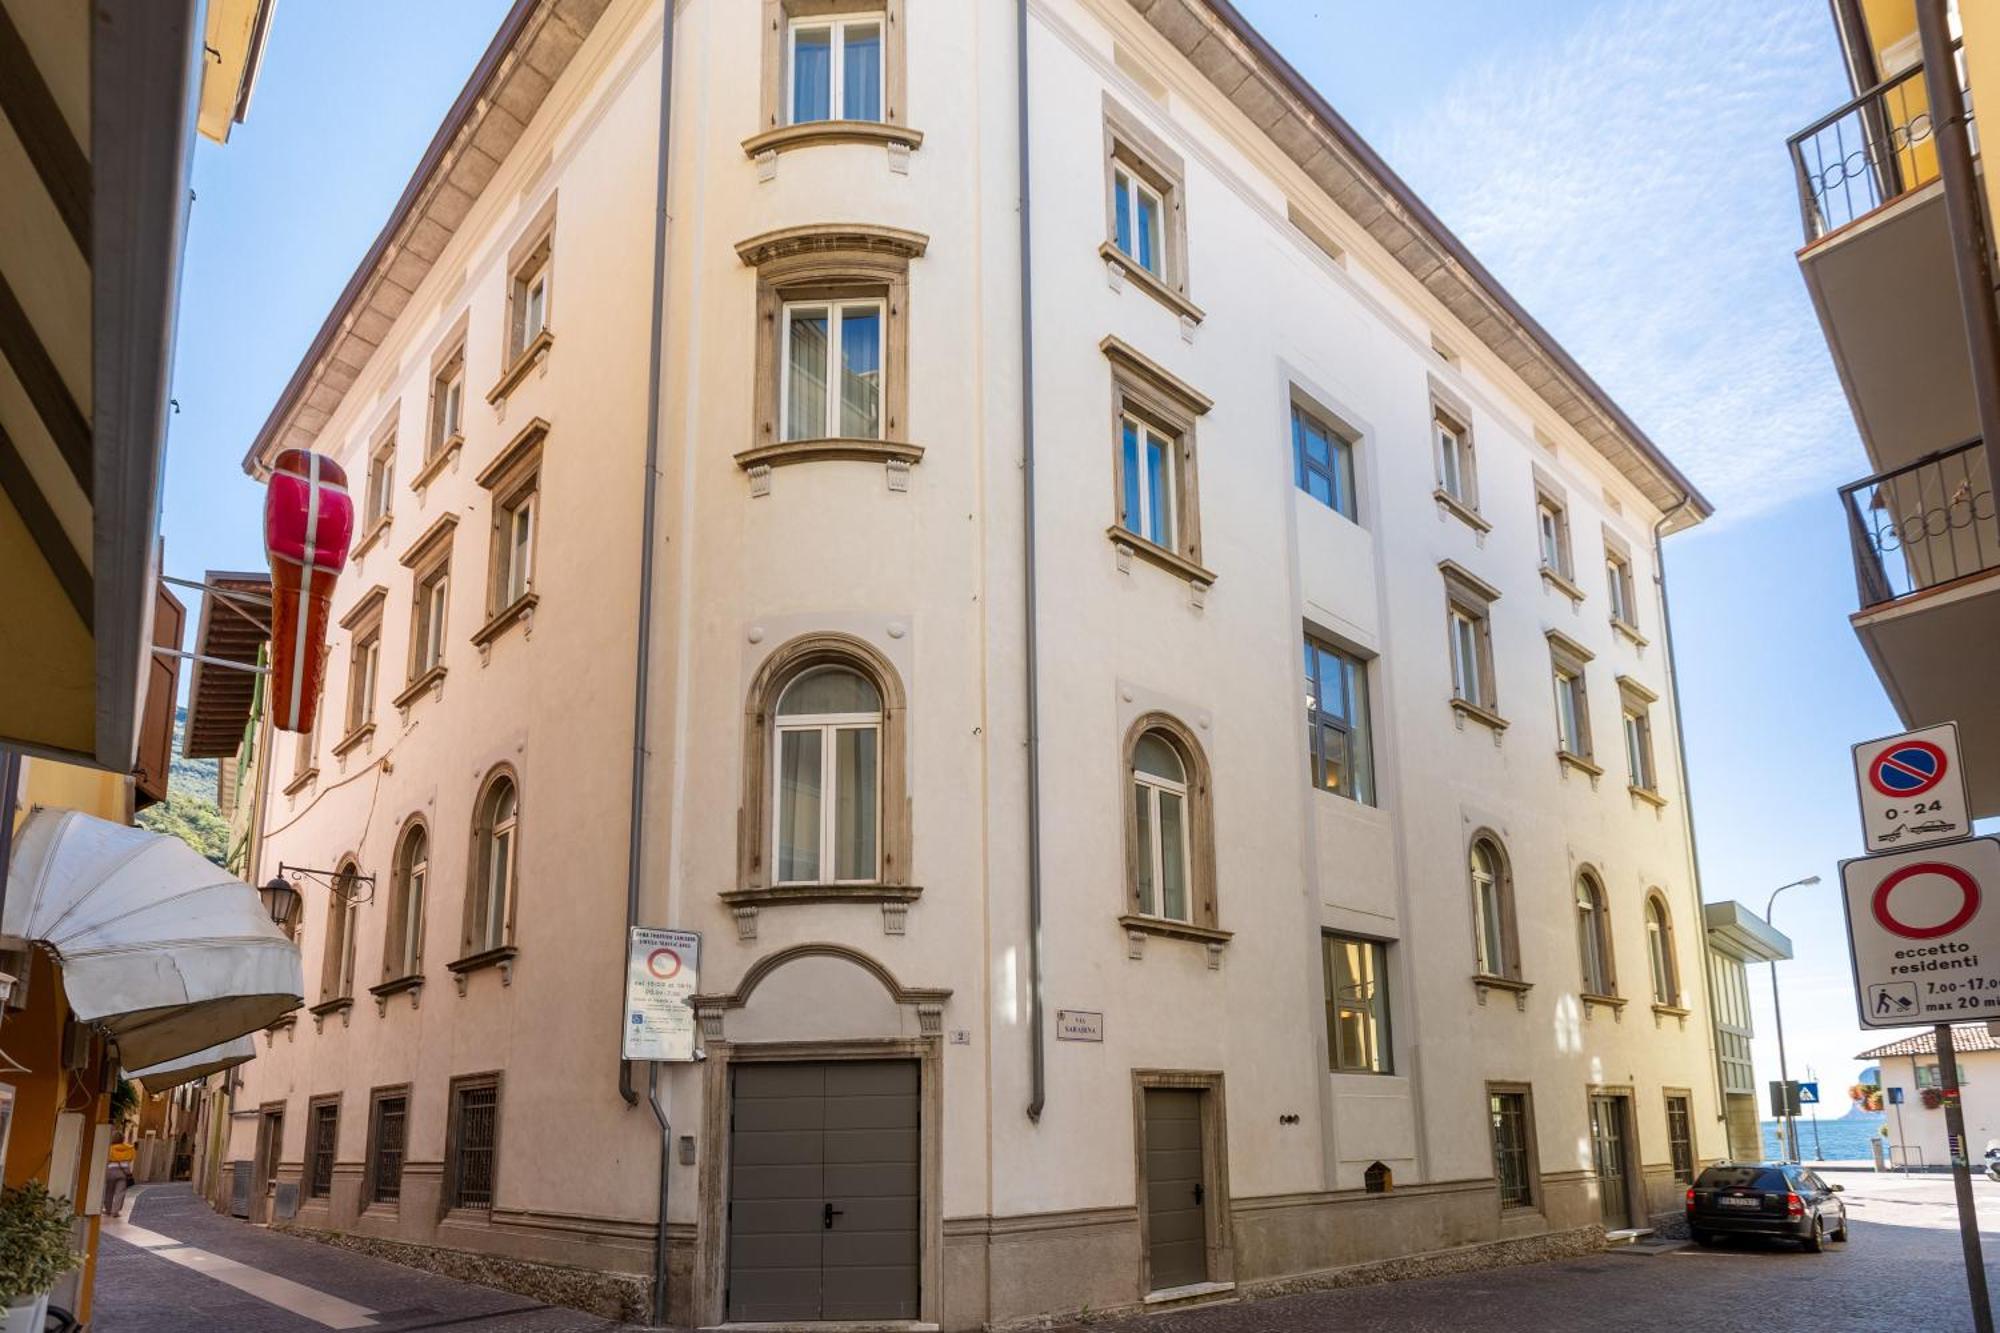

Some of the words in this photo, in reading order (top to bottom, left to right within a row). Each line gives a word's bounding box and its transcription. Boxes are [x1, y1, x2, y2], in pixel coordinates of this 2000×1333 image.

[1895, 942, 1969, 959] eccetto
[1891, 955, 1978, 975] residenti
[1927, 978, 2000, 995] 7.00-17.0
[1926, 1002, 1952, 1012] max
[1958, 996, 1980, 1009] 20
